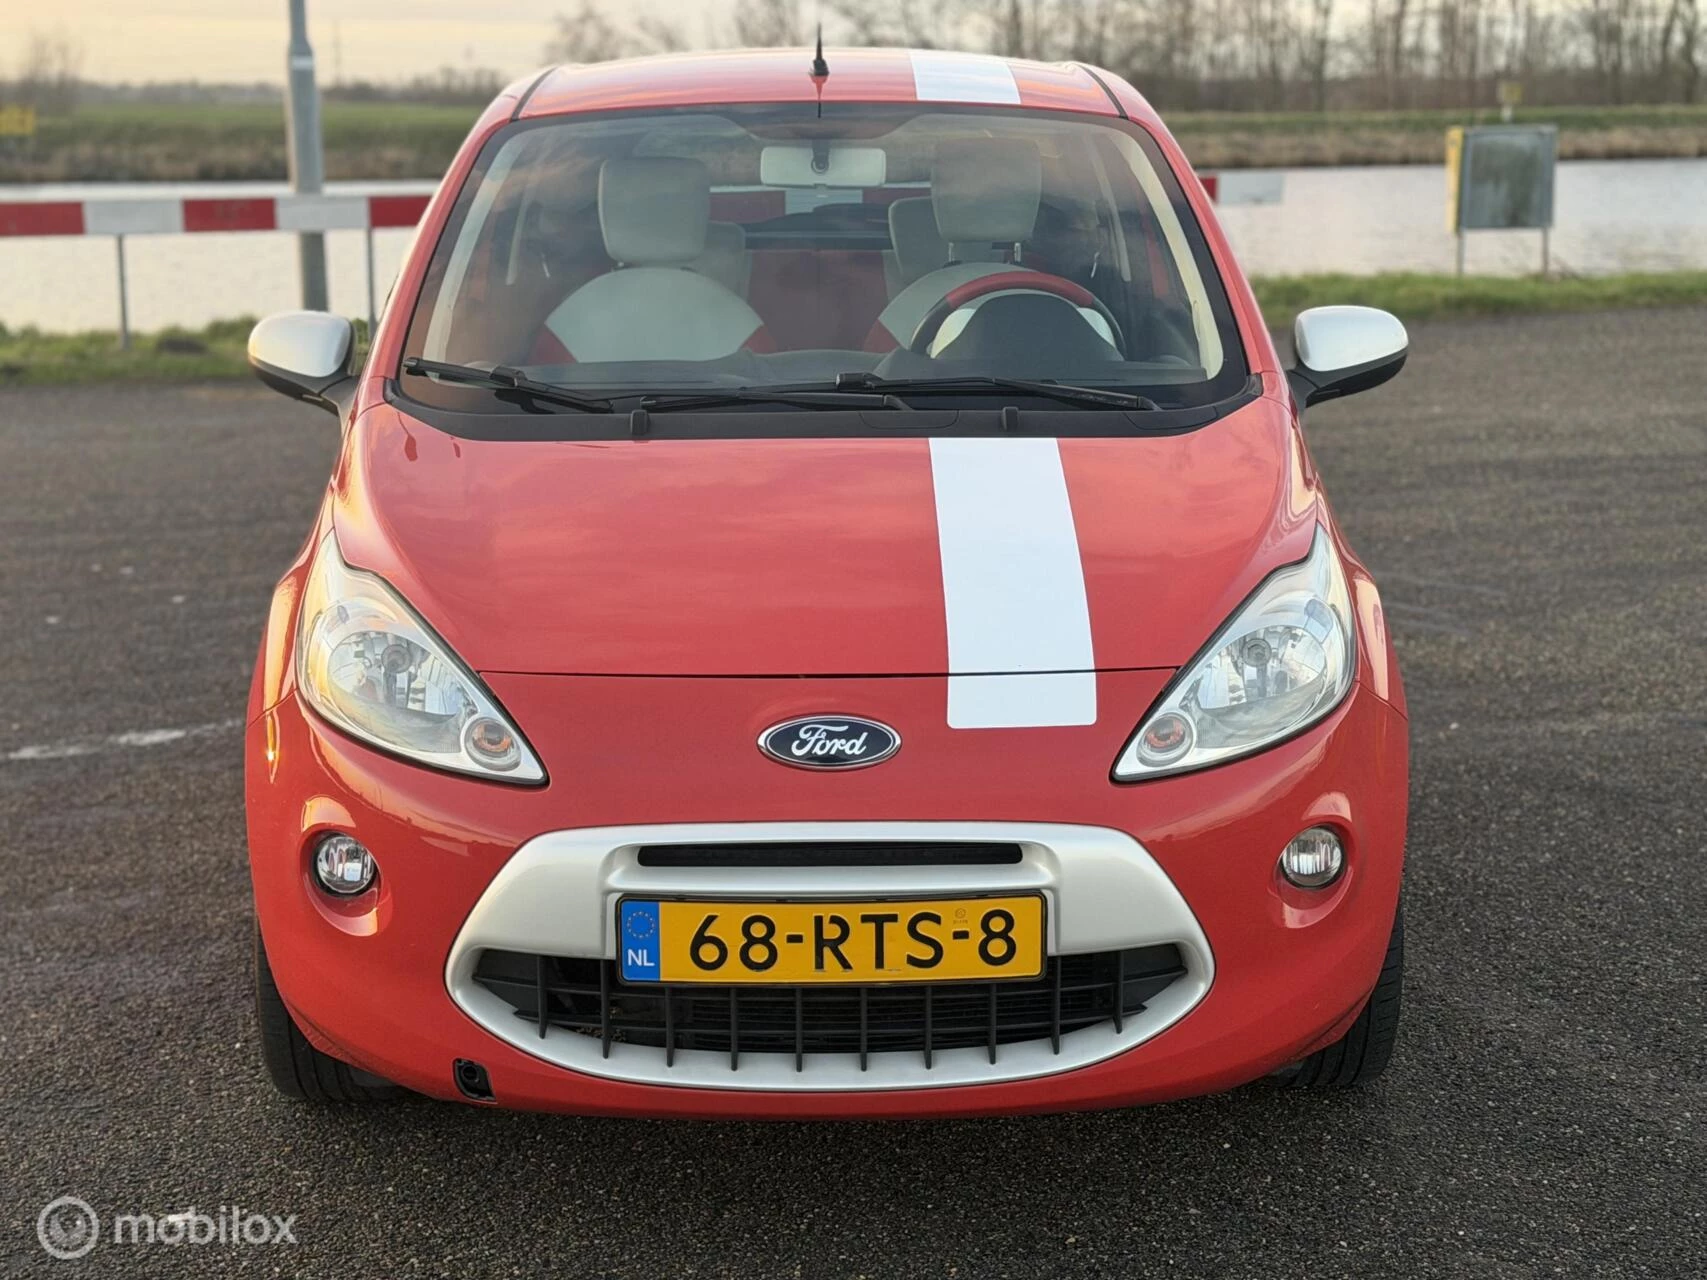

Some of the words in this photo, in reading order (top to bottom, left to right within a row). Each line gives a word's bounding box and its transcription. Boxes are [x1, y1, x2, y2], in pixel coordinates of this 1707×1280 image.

[791, 724, 868, 757] Ford
[688, 908, 1018, 972] 68-RTS-8
[627, 948, 656, 967] NL
